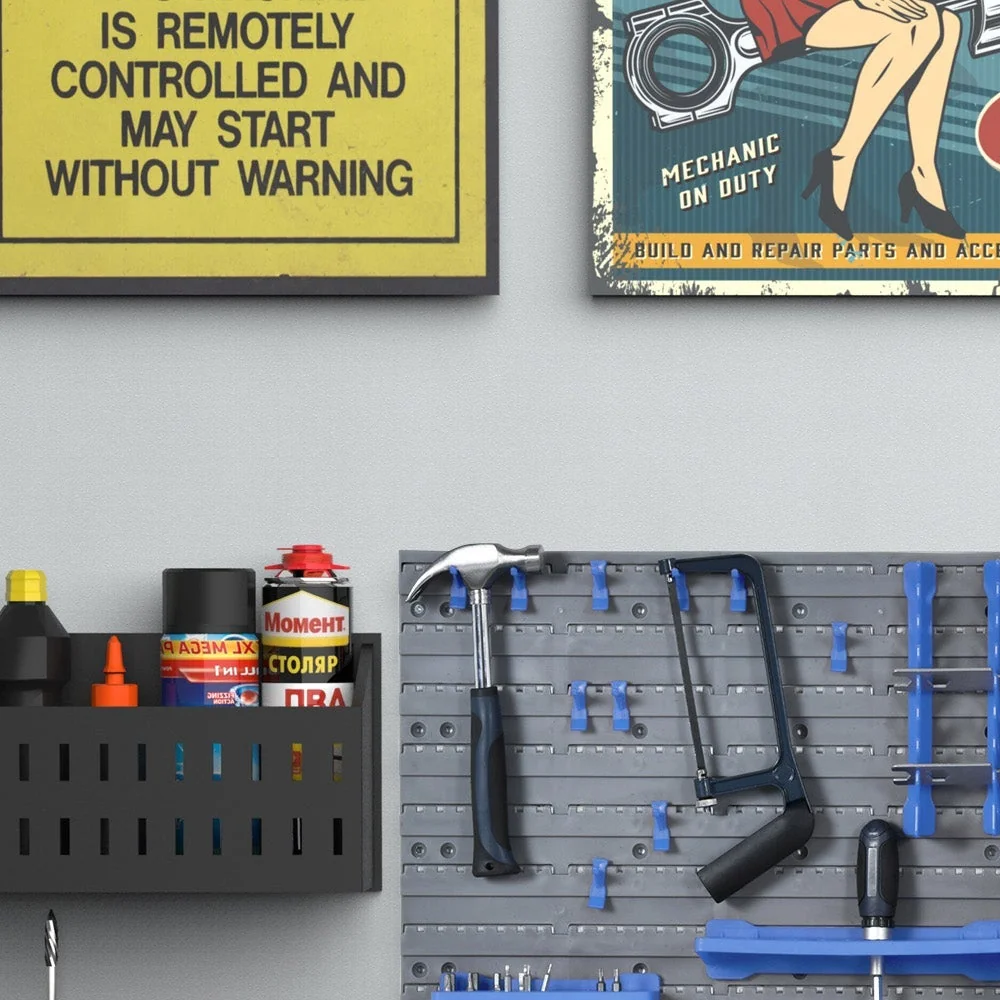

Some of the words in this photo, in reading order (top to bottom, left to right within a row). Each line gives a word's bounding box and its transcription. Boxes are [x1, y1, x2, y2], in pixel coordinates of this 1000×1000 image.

[101, 12, 137, 49] IS
[157, 12, 355, 49] REMOTELY
[50, 60, 308, 99] CONTROLLED
[327, 61, 407, 99] AND
[120, 110, 198, 148] MAY
[217, 109, 336, 148] START
[45, 159, 219, 197] WITHOUT
[237, 159, 414, 197] WARNING
[660, 133, 780, 187] MECHANIC
[679, 183, 708, 210] ON
[719, 164, 777, 198] DUTY
[634, 242, 693, 259] BUILD
[702, 242, 743, 259] AND
[752, 242, 823, 259] REPAIR
[832, 242, 897, 259] PARTS
[906, 242, 947, 259] AND
[264, 611, 346, 633] Момент
[268, 654, 338, 675] СТОЛЯР
